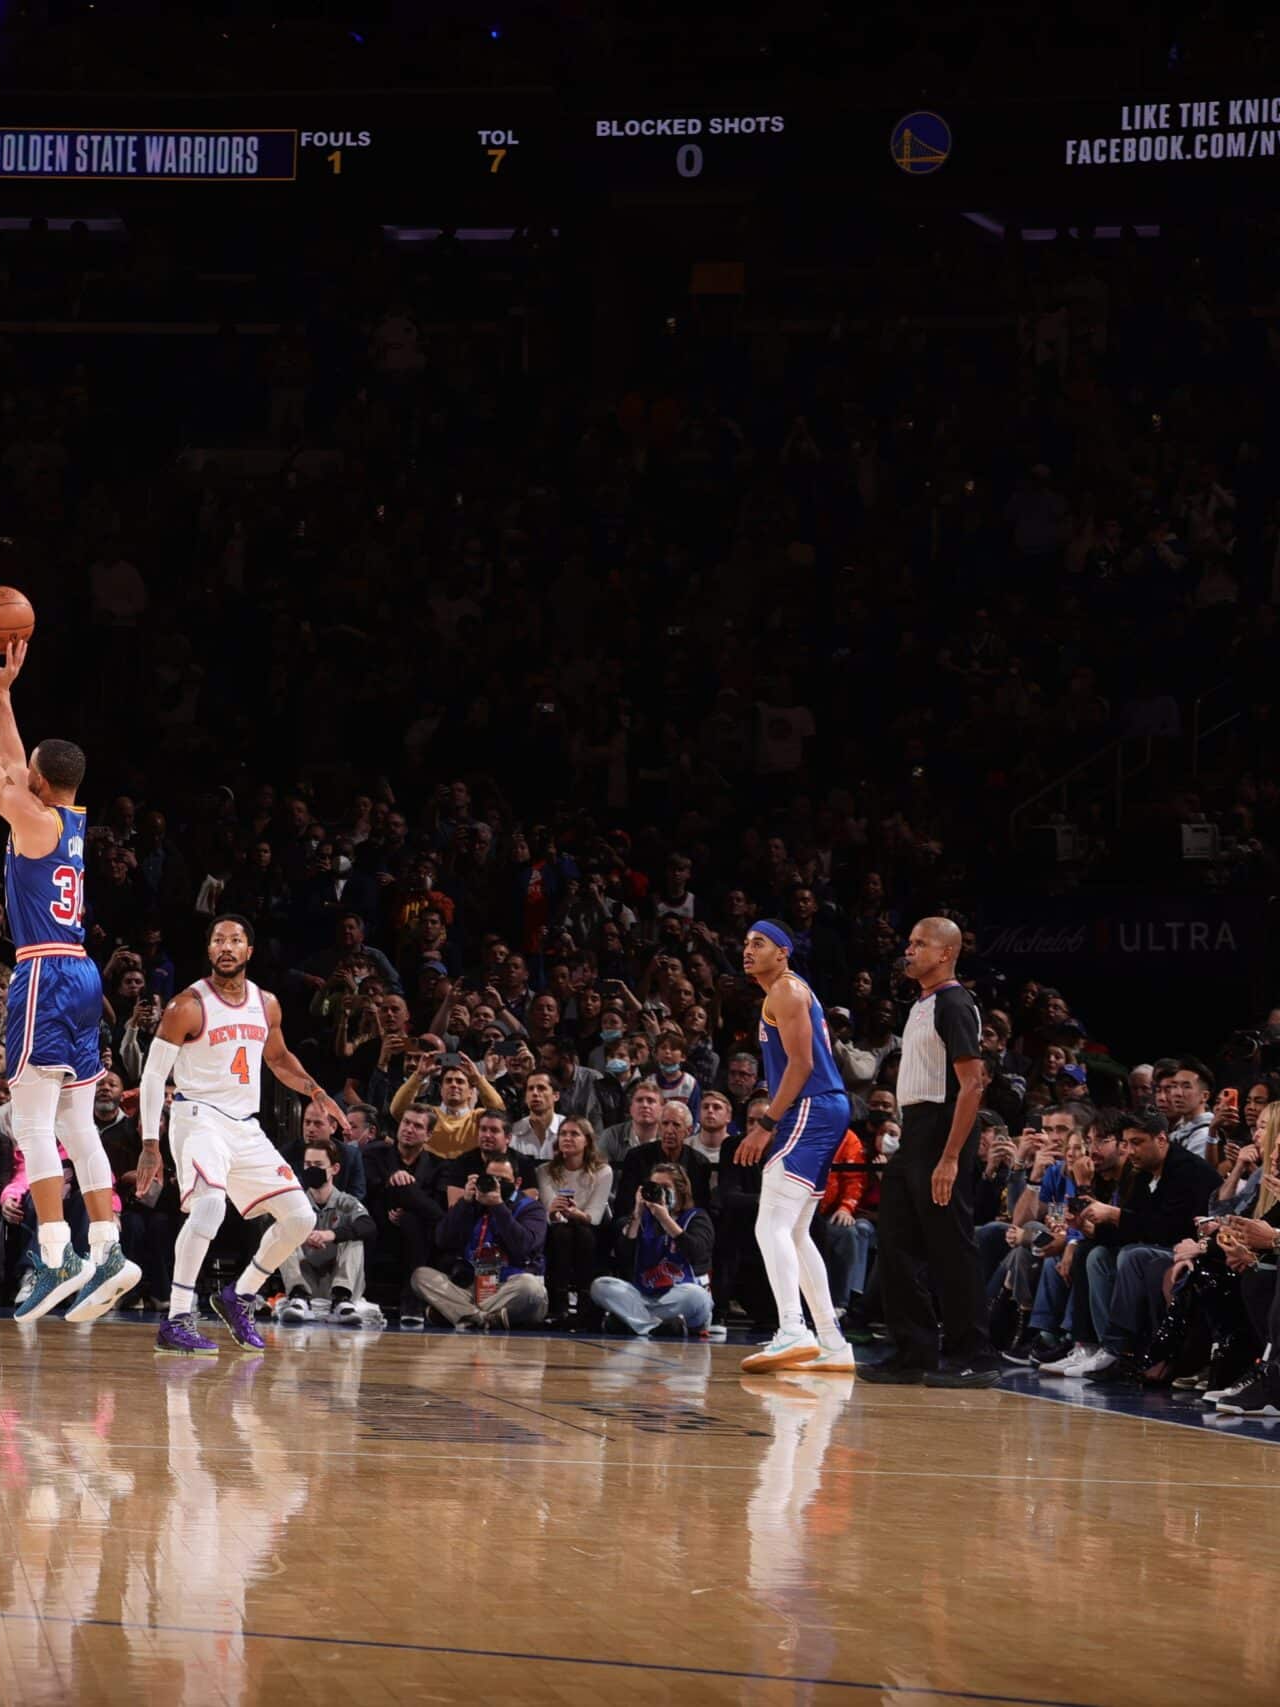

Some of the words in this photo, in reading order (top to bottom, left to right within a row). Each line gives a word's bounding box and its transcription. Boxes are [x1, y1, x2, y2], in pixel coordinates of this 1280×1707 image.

[596, 119, 702, 137] BLOCKED
[709, 116, 785, 134] SHOTS
[1121, 104, 1170, 131] LIKE
[1179, 101, 1220, 128] THE
[300, 131, 371, 147] FOULS
[478, 130, 519, 145] TOL
[1065, 131, 1280, 165] FACEBOOK.COM/N
[75, 135, 137, 173] STATE
[145, 136, 259, 174] WARRIORS
[327, 150, 342, 174] 1
[487, 149, 507, 173] 7
[676, 144, 704, 177] 0
[1119, 919, 1237, 952] ULTRA
[208, 1024, 237, 1046] NEW
[230, 1046, 250, 1084] 4
